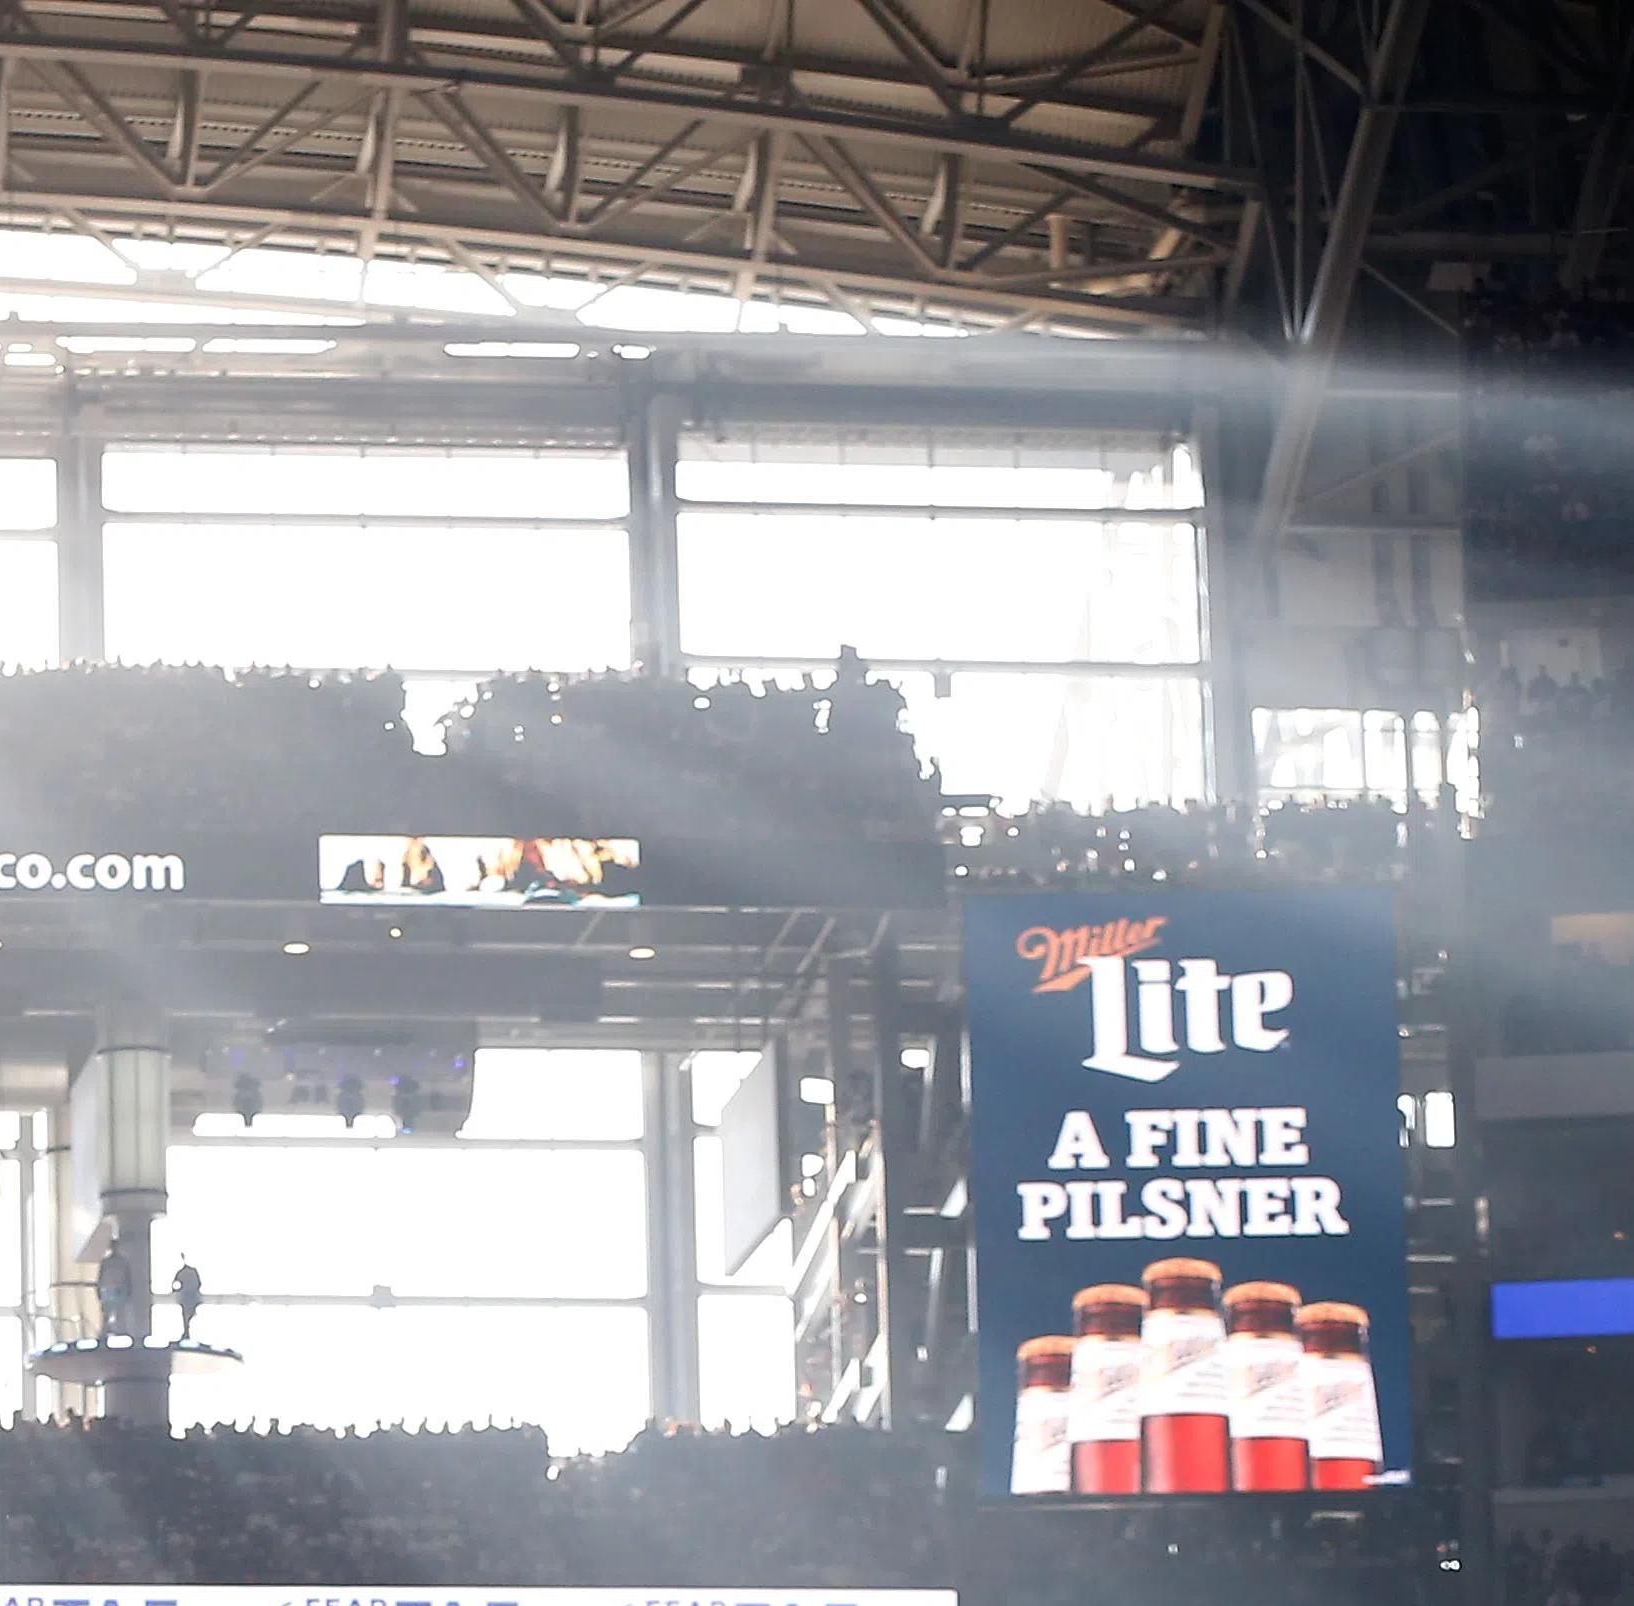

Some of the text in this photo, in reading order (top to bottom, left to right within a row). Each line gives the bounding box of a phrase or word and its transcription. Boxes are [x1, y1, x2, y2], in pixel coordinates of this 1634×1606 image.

[1016, 915, 1170, 986] Miller
[1077, 954, 1295, 1084] Lite
[1047, 1106, 1310, 1171] A FINE
[1017, 1176, 1350, 1241] PILSNER
